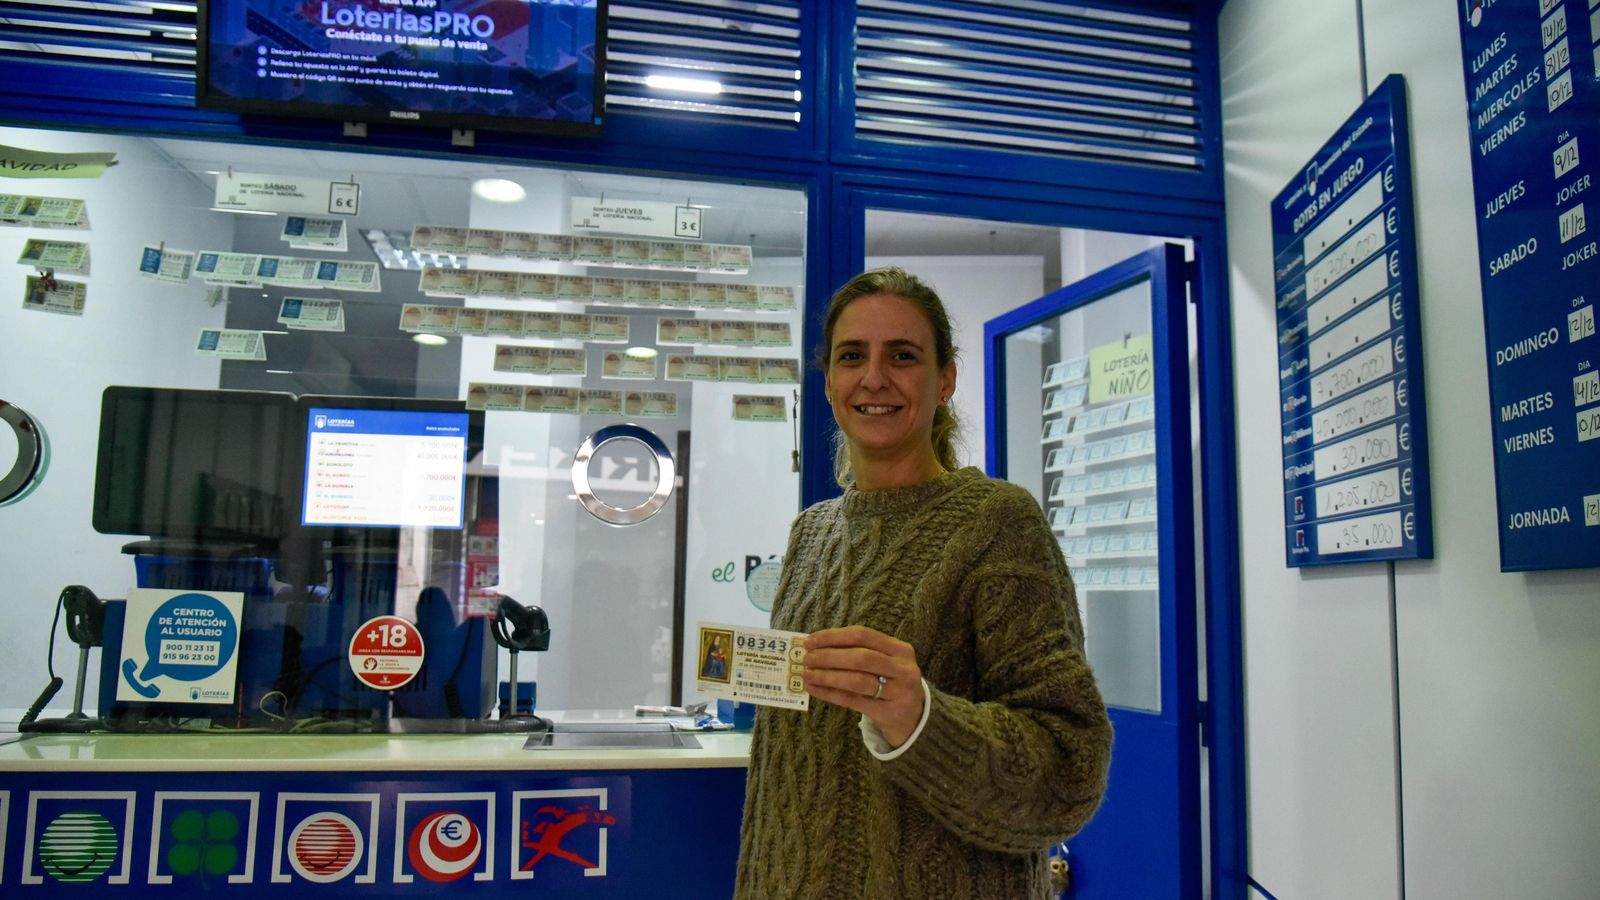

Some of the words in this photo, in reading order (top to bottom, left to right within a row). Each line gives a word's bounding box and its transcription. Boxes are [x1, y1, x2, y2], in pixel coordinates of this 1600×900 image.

[325, 27, 382, 42] Conéctate
[384, 34, 392, 43] a
[394, 33, 407, 44] tu
[407, 36, 440, 48] punto
[441, 38, 456, 48] de
[457, 39, 488, 51] venta
[1472, 31, 1508, 74] LUNES
[1475, 53, 1518, 101] MARTES
[1478, 66, 1541, 130] MIERCOLES
[1480, 110, 1526, 156] VIERNES
[1557, 130, 1570, 143] DIA
[263, 182, 297, 192] SÁBADO
[1384, 165, 1395, 192] €
[1555, 174, 1591, 206] JOKER
[335, 198, 343, 207] 6
[346, 199, 353, 208] €
[1293, 200, 1317, 234] BOTES
[1318, 187, 1331, 210] EN
[1332, 157, 1364, 198] JUEGO
[1485, 180, 1526, 219] JUEVES
[614, 206, 643, 216] JUEVES
[1386, 206, 1397, 234] €
[680, 222, 688, 231] 3
[689, 222, 697, 231] €
[1389, 250, 1400, 277] €
[1489, 237, 1537, 276] SABADO
[1562, 242, 1598, 271] JOKER
[1391, 292, 1402, 320] €
[1572, 295, 1585, 307] DIA
[1394, 335, 1405, 363] €
[1496, 327, 1559, 366] DOMINGO
[1103, 348, 1149, 373] LOTERÍA
[1578, 360, 1591, 371] DIA
[1396, 379, 1408, 407] €
[1501, 391, 1553, 422] MARTES
[1399, 422, 1410, 451] €
[1504, 426, 1554, 453] VIERNES
[1401, 467, 1413, 496] €
[1403, 511, 1415, 541] €
[1508, 506, 1570, 530] JORNADA
[712, 561, 736, 582] el
[159, 617, 173, 625] DE
[175, 617, 227, 628] ATENCIÓN
[172, 608, 215, 617] CENTRO
[160, 627, 175, 635] AL
[177, 627, 222, 637] USUARIO
[366, 624, 407, 648] +18
[736, 635, 787, 653] 08343
[194, 644, 204, 652] 23
[736, 651, 759, 659] LOTERÍA
[759, 653, 786, 662] NACIONAL
[753, 659, 777, 667] NAVIDAD
[792, 680, 801, 688] 20
